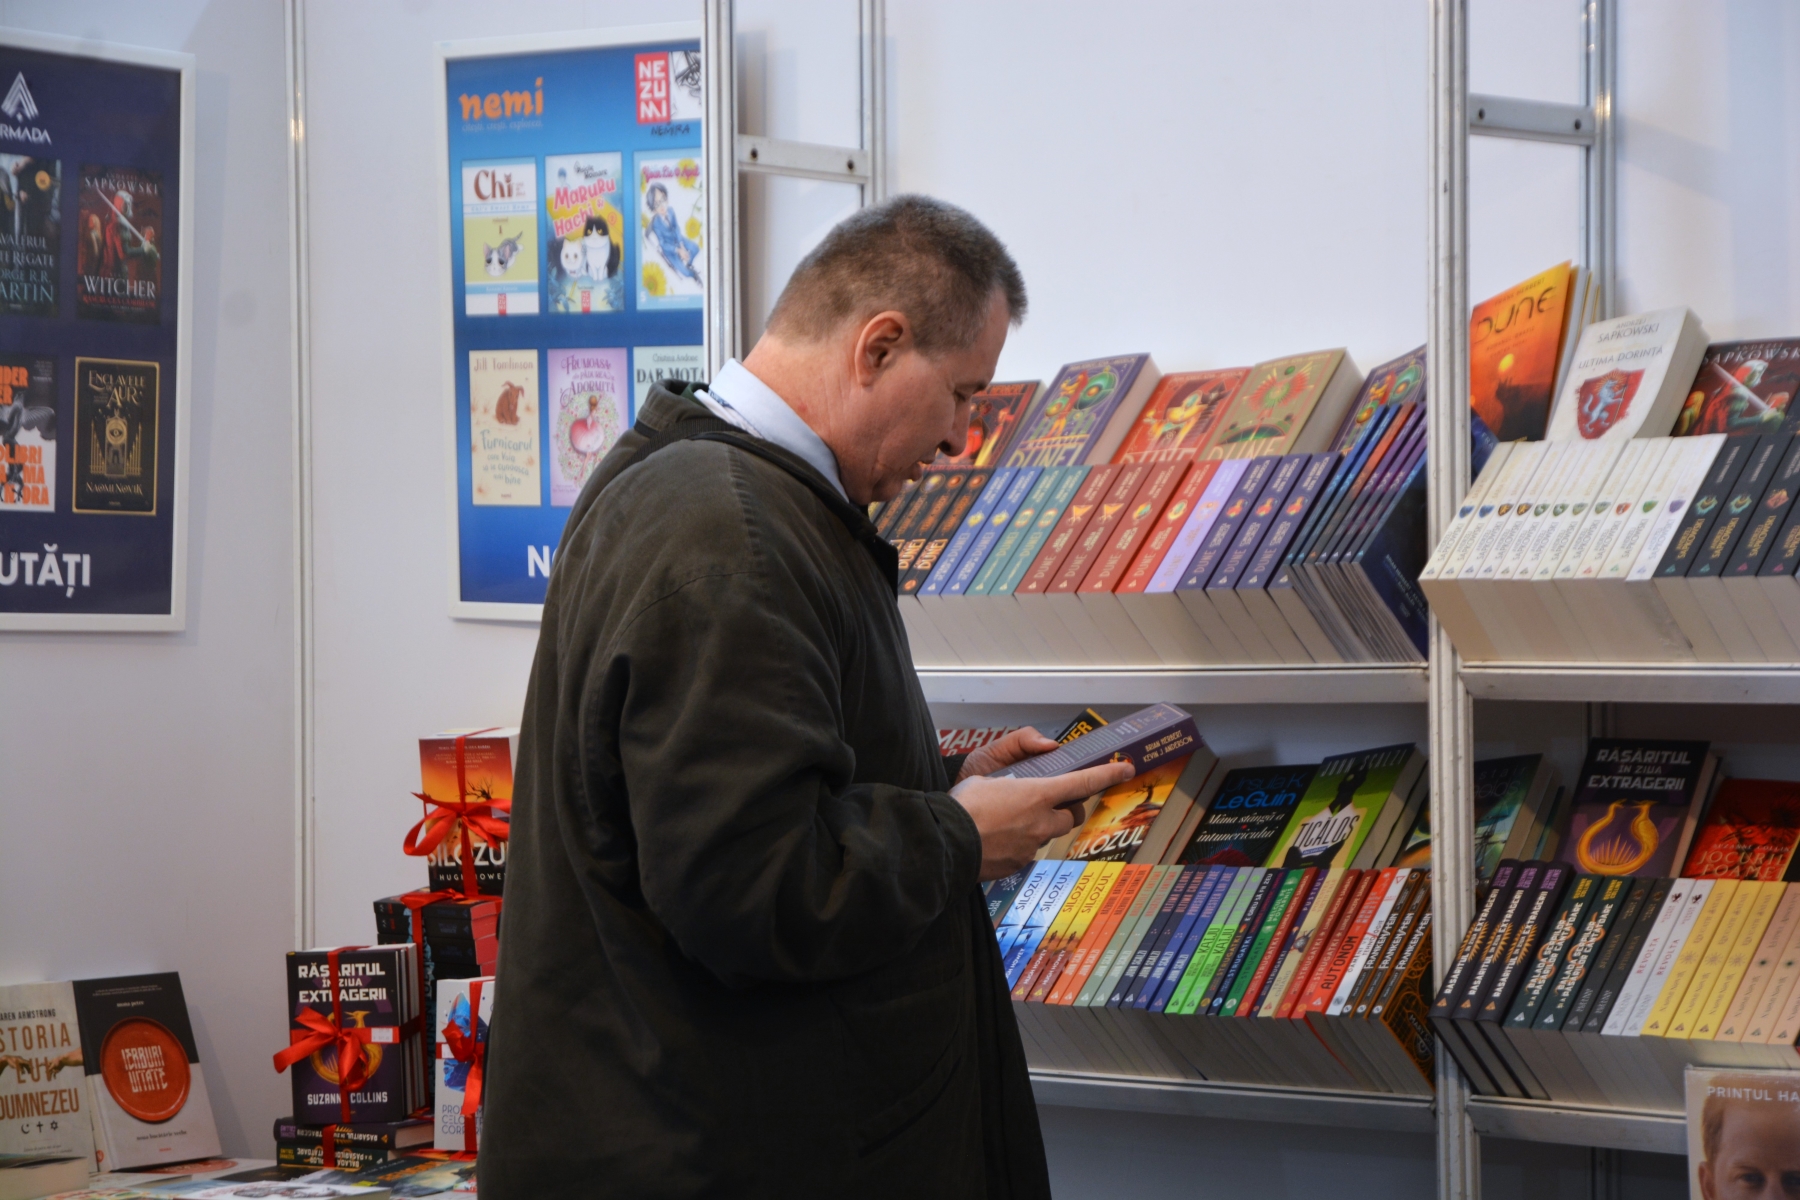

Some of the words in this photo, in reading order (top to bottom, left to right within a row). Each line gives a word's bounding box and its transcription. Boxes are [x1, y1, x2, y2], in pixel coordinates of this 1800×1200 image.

[638, 60, 666, 79] NE
[458, 77, 543, 120] nemi
[639, 79, 667, 99] ZU
[639, 100, 668, 121] MI
[84, 176, 159, 196] SAPKOWSKI
[473, 169, 514, 201] Chi
[553, 203, 595, 238] Hachi
[83, 274, 156, 300] WITCHER
[1597, 322, 1661, 344] SAPKOWSKI
[473, 357, 487, 372] Jill
[492, 356, 534, 371] Tomlinson
[1577, 355, 1615, 370] ULTIMA
[106, 386, 140, 409] AUR
[1436, 522, 1466, 560] SAPKOWSKI
[1456, 522, 1485, 560] SAPKOWSKI
[1475, 521, 1505, 559] SAPKOWSKI
[1494, 520, 1523, 558] SAPKOWSKI
[1510, 521, 1540, 560] SAPKOWSKI
[1529, 521, 1559, 560] SAPKOWSKI
[1550, 521, 1578, 560] SAPKOWSKI
[1572, 519, 1601, 558] SAPKOWSKI
[1593, 520, 1622, 559] SAPKOWSKI
[1620, 518, 1649, 557] SAPKOWSKI
[1676, 518, 1706, 558] SAPKOWSKI
[1710, 517, 1740, 557] SAPKOWSKI
[1748, 515, 1777, 556] SAPKOWSKI
[1032, 553, 1058, 577] DUNE
[1063, 553, 1088, 576] DUNE
[1098, 553, 1123, 576] DUNE
[1132, 552, 1157, 576] DUNE
[1192, 549, 1217, 573] DUNE
[1222, 548, 1247, 572] DUNE
[1252, 548, 1278, 571] DUNE
[1142, 750, 1160, 763] KEVIN
[1165, 735, 1194, 754] ANDERSON
[1144, 740, 1161, 752] BRIAN
[1161, 729, 1183, 745] HERBERT
[1319, 757, 1357, 777] JOHN
[1359, 749, 1408, 771] SCALZI
[1595, 746, 1692, 765] RĂSĂRITUL
[1225, 772, 1287, 793] Ursula
[1587, 774, 1686, 791] EXTRAGERII
[1635, 764, 1662, 775] ZIUA
[1206, 812, 1239, 825] Mâna
[1066, 825, 1144, 860] SILOZUL
[1196, 825, 1279, 843] întunericului
[1700, 863, 1784, 881] FOAMEI
[1013, 869, 1047, 910] SILOZUL
[1038, 871, 1072, 911] SILOZUL
[1061, 871, 1095, 912] SILOZUL
[1079, 872, 1114, 913] SILOZUL
[1473, 888, 1501, 931] EXTRAGERII
[1496, 889, 1524, 932] EXTRAGERII
[1521, 891, 1549, 934] EXTRAGERII
[1196, 927, 1221, 953] KAIJU
[1211, 928, 1236, 953] KAIJU
[1010, 947, 1026, 969] HOWEY
[1031, 949, 1048, 968] HOWEY
[1050, 950, 1066, 969] HOWEY
[1130, 948, 1148, 964] SCALZI
[1144, 950, 1162, 965] SCALZI
[1156, 950, 1175, 965] SCALZI
[1172, 953, 1190, 968] SCALZI
[1215, 935, 1242, 975] STRUGATKI
[1226, 936, 1253, 976] STRUGATKI
[1253, 937, 1281, 979] STRUGATKI
[1265, 950, 1287, 983] STRUGATKI
[1296, 938, 1324, 979] STRUGATKI
[1312, 938, 1340, 980] STRUGATKI
[1319, 935, 1359, 989] AUTONOM
[1635, 937, 1661, 973] REVOLTA
[1655, 938, 1680, 975] REVOLTA
[298, 961, 386, 978] RĂSRITUL
[338, 977, 363, 987] ZIUA
[1526, 957, 1548, 988] BALADA
[1556, 959, 1578, 989] BALADA
[17, 1007, 57, 1021] ARMSTRONG
[350, 1091, 388, 1104] COLLINS
[1778, 1090, 1800, 1102] HA
